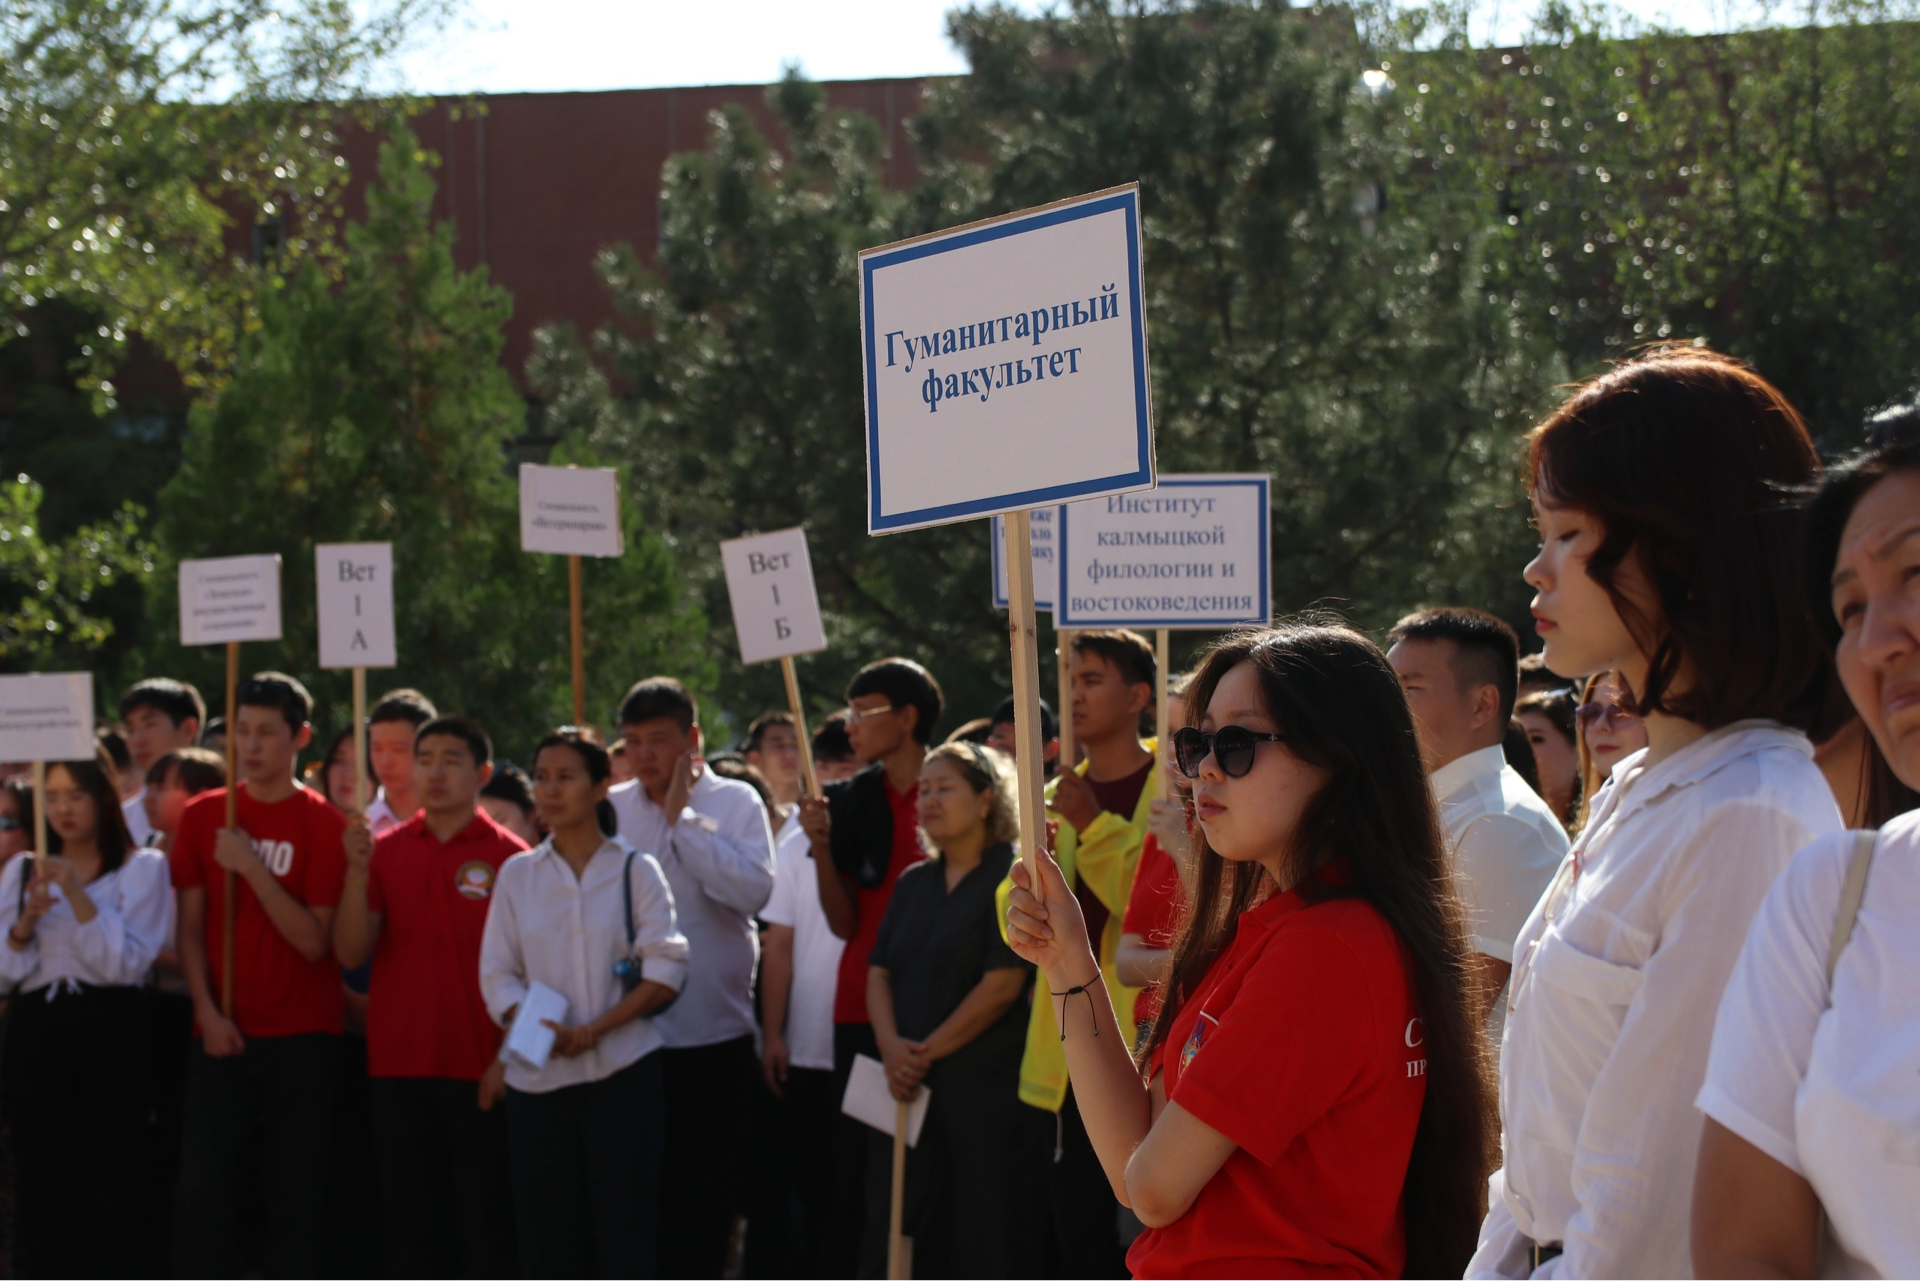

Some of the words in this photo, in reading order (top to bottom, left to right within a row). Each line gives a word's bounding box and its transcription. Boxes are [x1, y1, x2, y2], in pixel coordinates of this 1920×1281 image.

[884, 283, 1120, 374] Гуманитарный
[921, 347, 1082, 414] факультет
[1106, 495, 1216, 518] Институт
[1097, 526, 1226, 548] калмыцкой
[338, 559, 376, 582] Вет
[748, 551, 791, 575] Вет
[1086, 559, 1214, 585] филологии
[1221, 563, 1236, 578] и
[1070, 595, 1253, 613] востоковедения
[350, 628, 369, 651] А
[774, 616, 792, 640] Б
